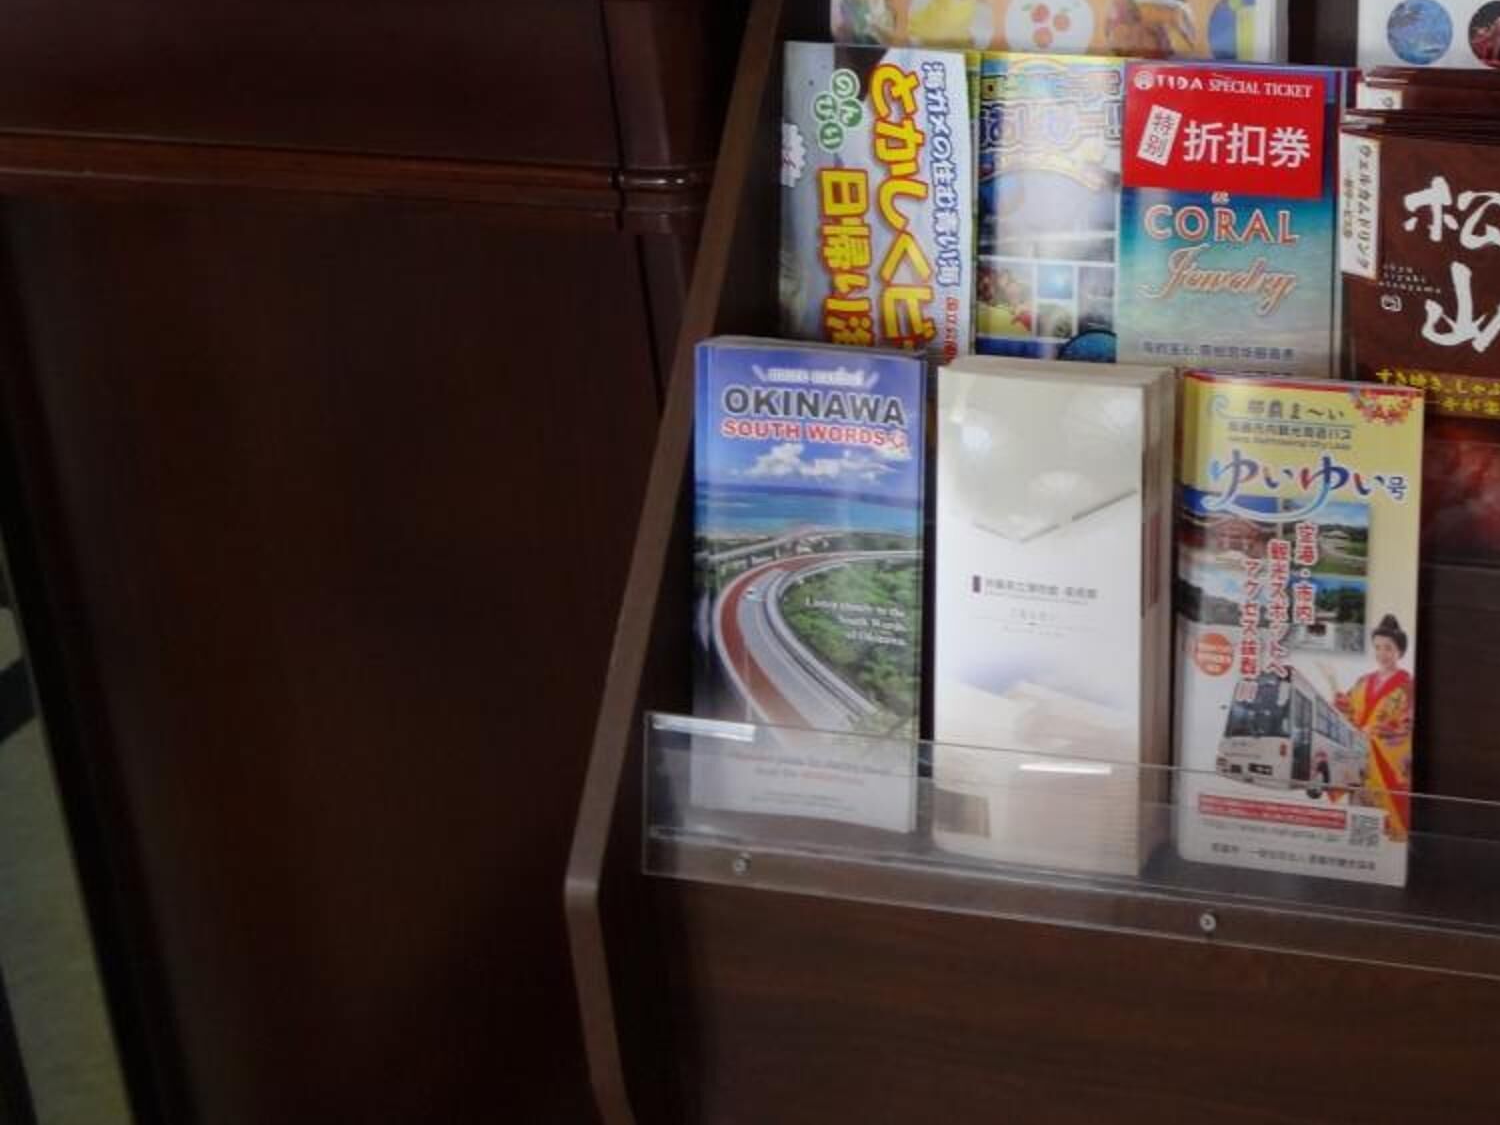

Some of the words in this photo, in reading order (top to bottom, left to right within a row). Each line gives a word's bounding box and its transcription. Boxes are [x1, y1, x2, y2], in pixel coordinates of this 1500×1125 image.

[1208, 79, 1260, 95] SPECIAL
[1264, 81, 1313, 98] TICKET
[1183, 120, 1312, 169] 折扣券
[1143, 203, 1300, 247] CORAL
[1137, 241, 1298, 317] Jewelry
[723, 386, 906, 427] OKINAWA
[723, 419, 801, 439] SOUTH
[1208, 450, 1408, 515] ゆいゆい号
